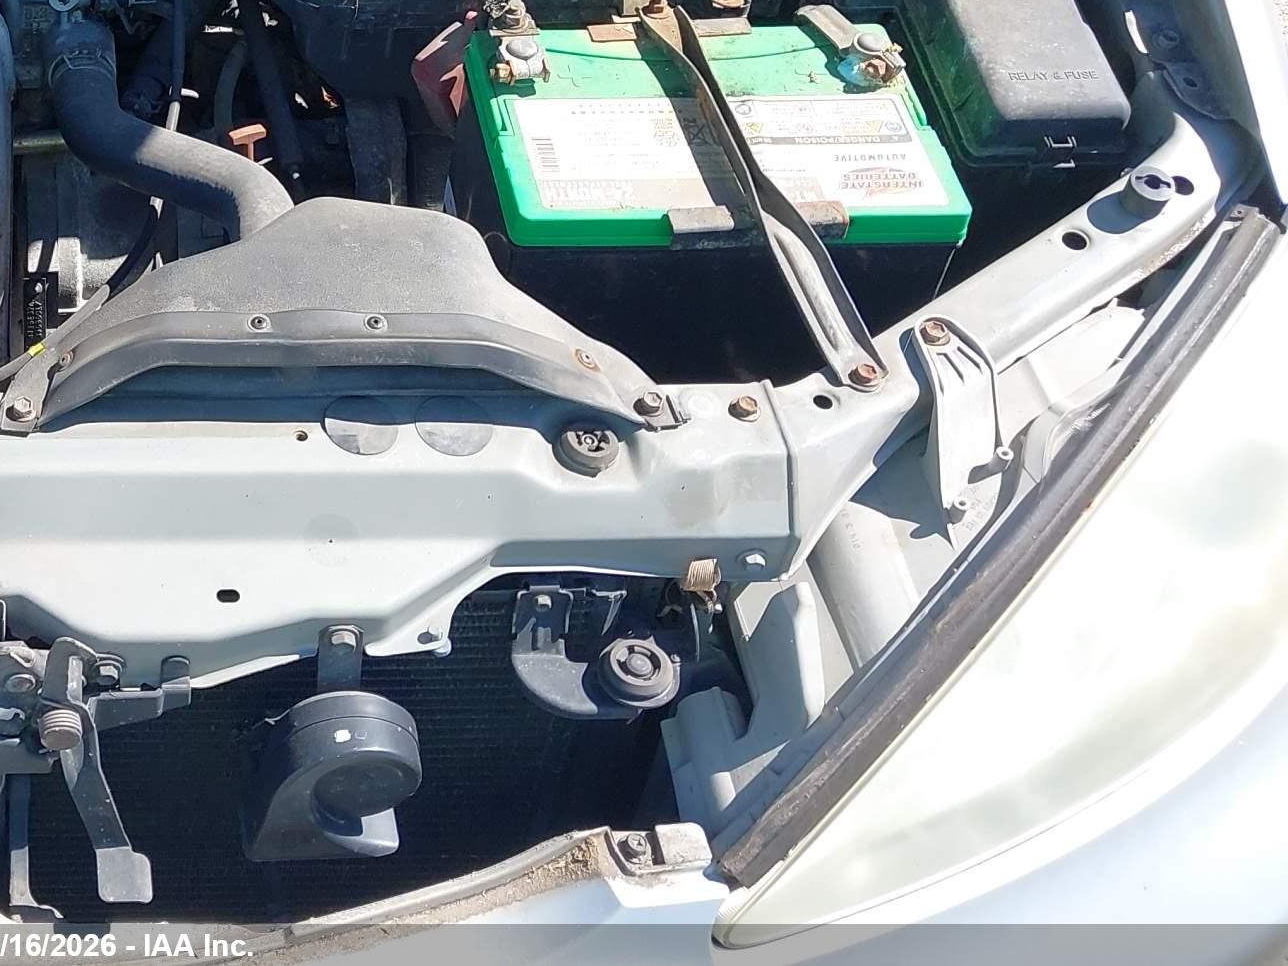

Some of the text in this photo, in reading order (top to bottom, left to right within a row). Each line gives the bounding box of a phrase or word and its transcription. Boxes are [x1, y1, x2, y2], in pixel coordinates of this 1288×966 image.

[1007, 71, 1048, 81] RELAY
[1063, 70, 1100, 80] FUSE
[795, 136, 881, 144] DANGER/POISON
[833, 153, 907, 162] AUTOMOTIVE
[840, 180, 924, 189] INTERSTATE
